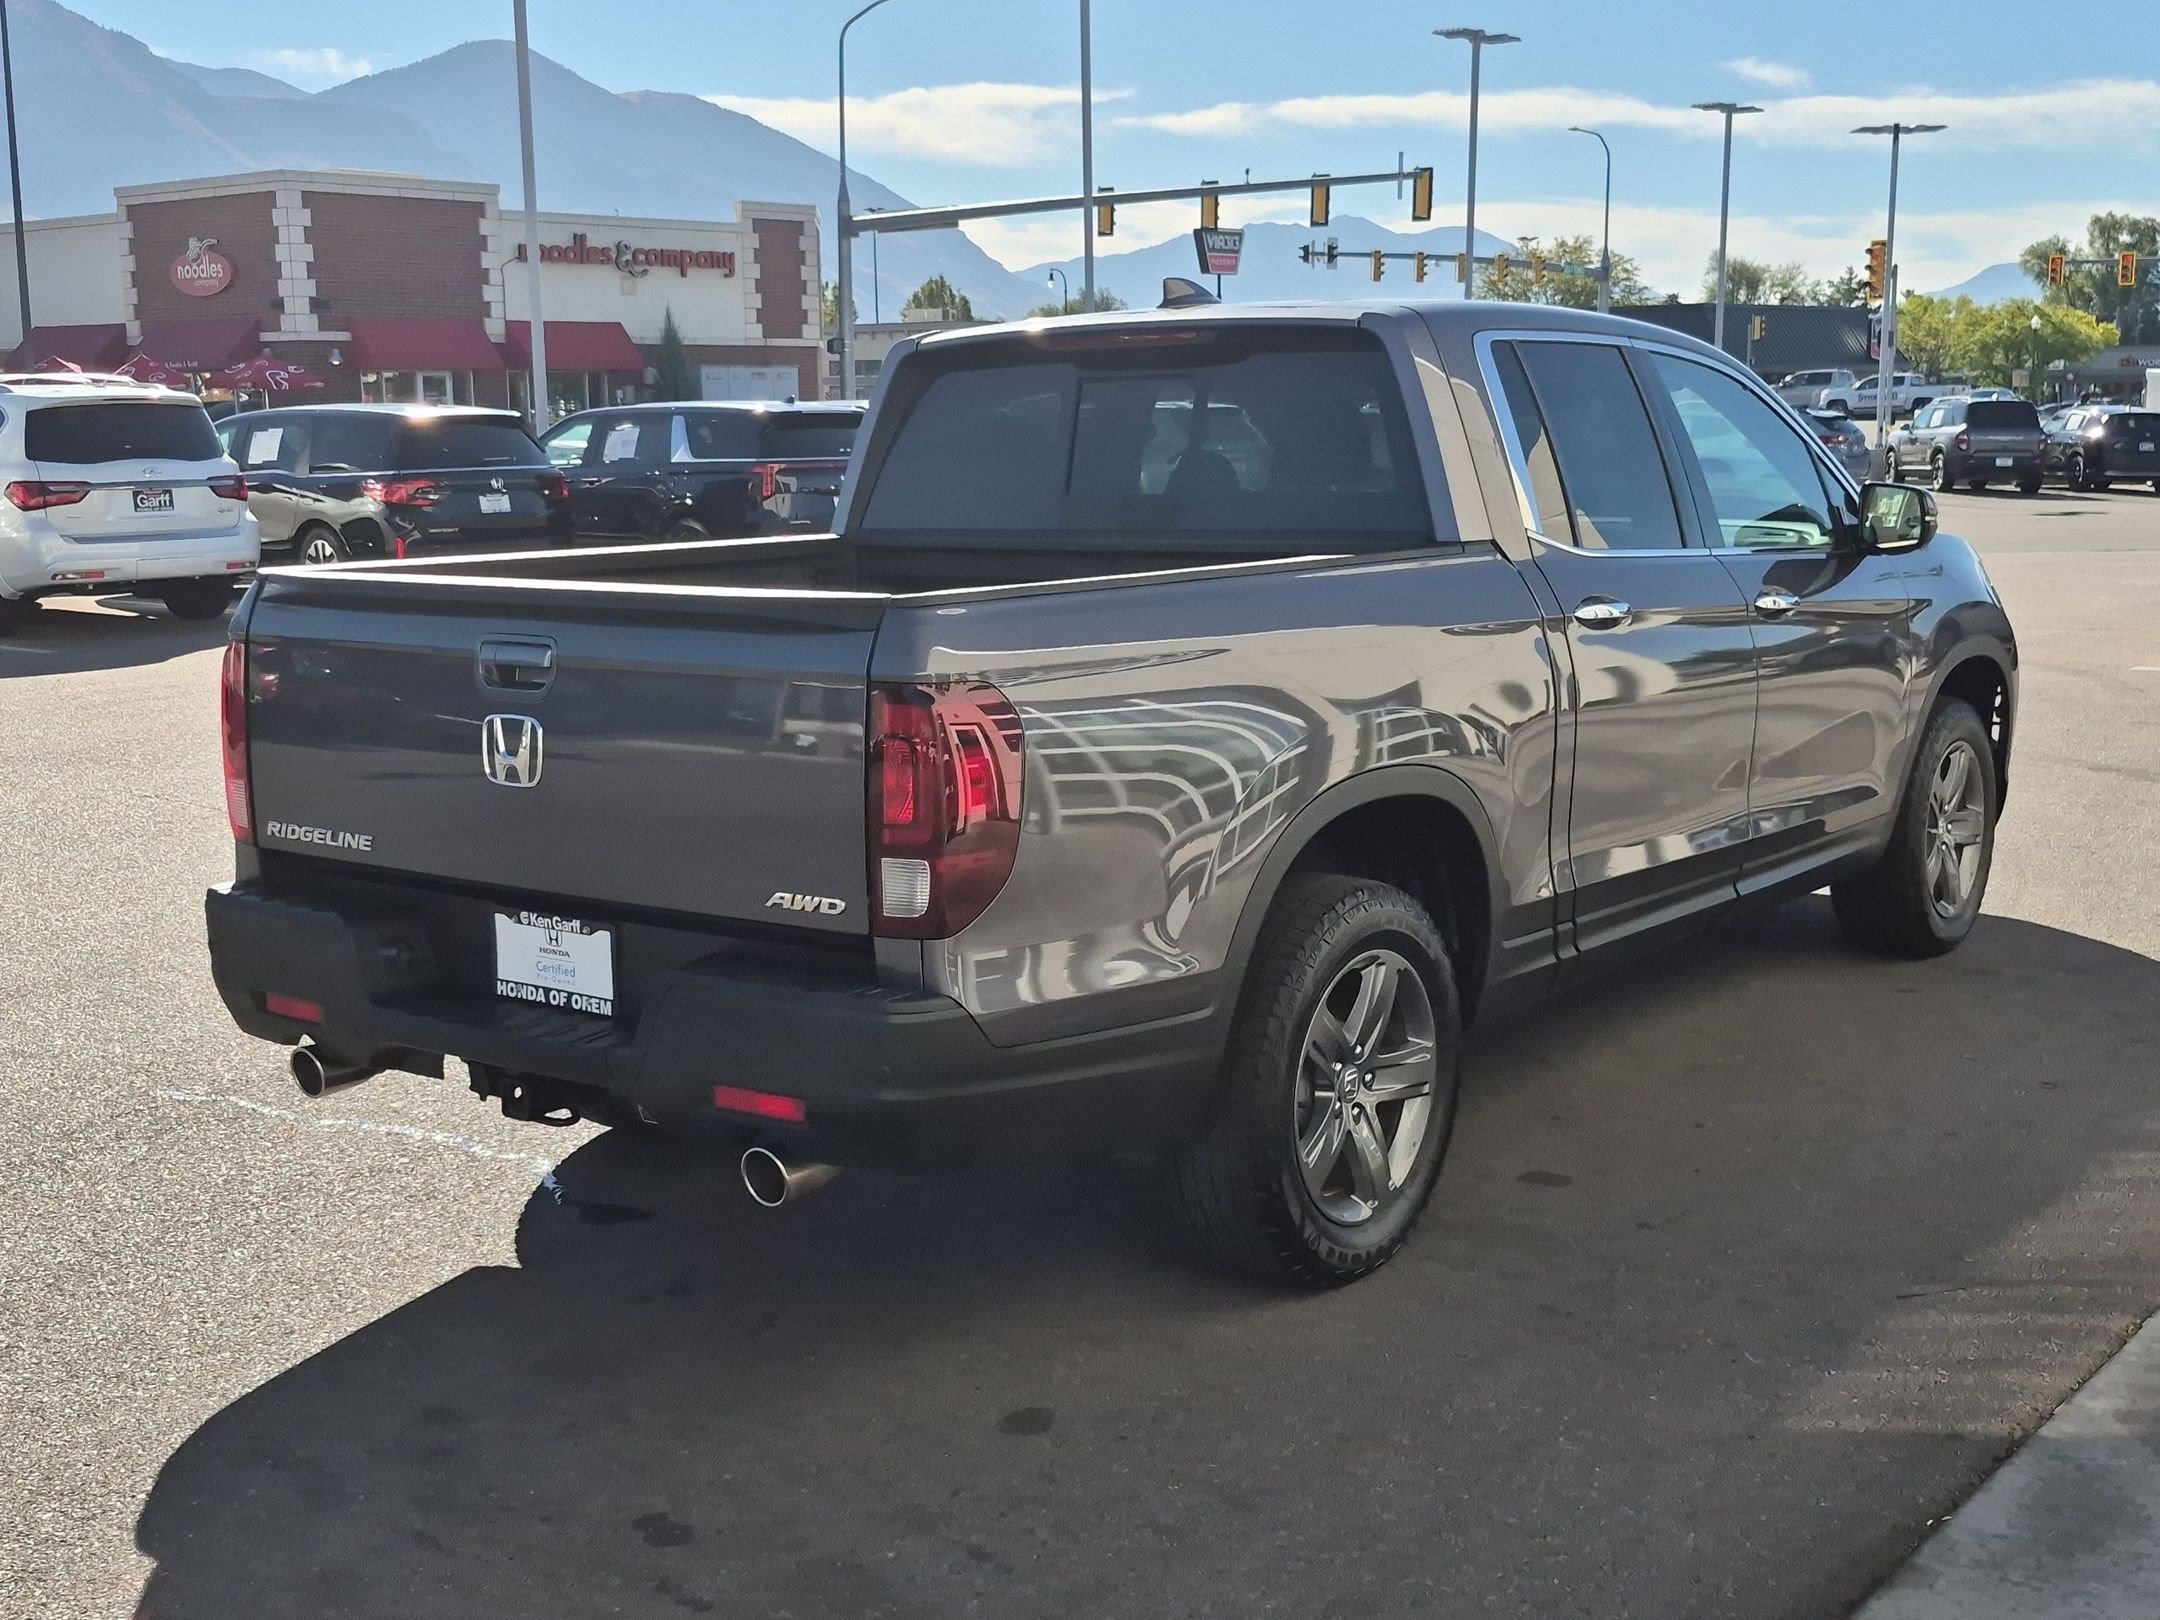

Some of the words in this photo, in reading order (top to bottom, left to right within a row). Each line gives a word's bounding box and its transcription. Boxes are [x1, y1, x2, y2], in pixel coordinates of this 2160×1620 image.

[177, 254, 223, 279] noodles
[137, 494, 171, 508] Garff
[266, 820, 373, 852] RIDGELINE
[764, 892, 846, 915] AWD
[538, 947, 571, 958] HONDA
[536, 960, 576, 978] Certified
[496, 980, 546, 1003] HONDA
[549, 990, 568, 1007] OF
[571, 994, 612, 1016] OREM
